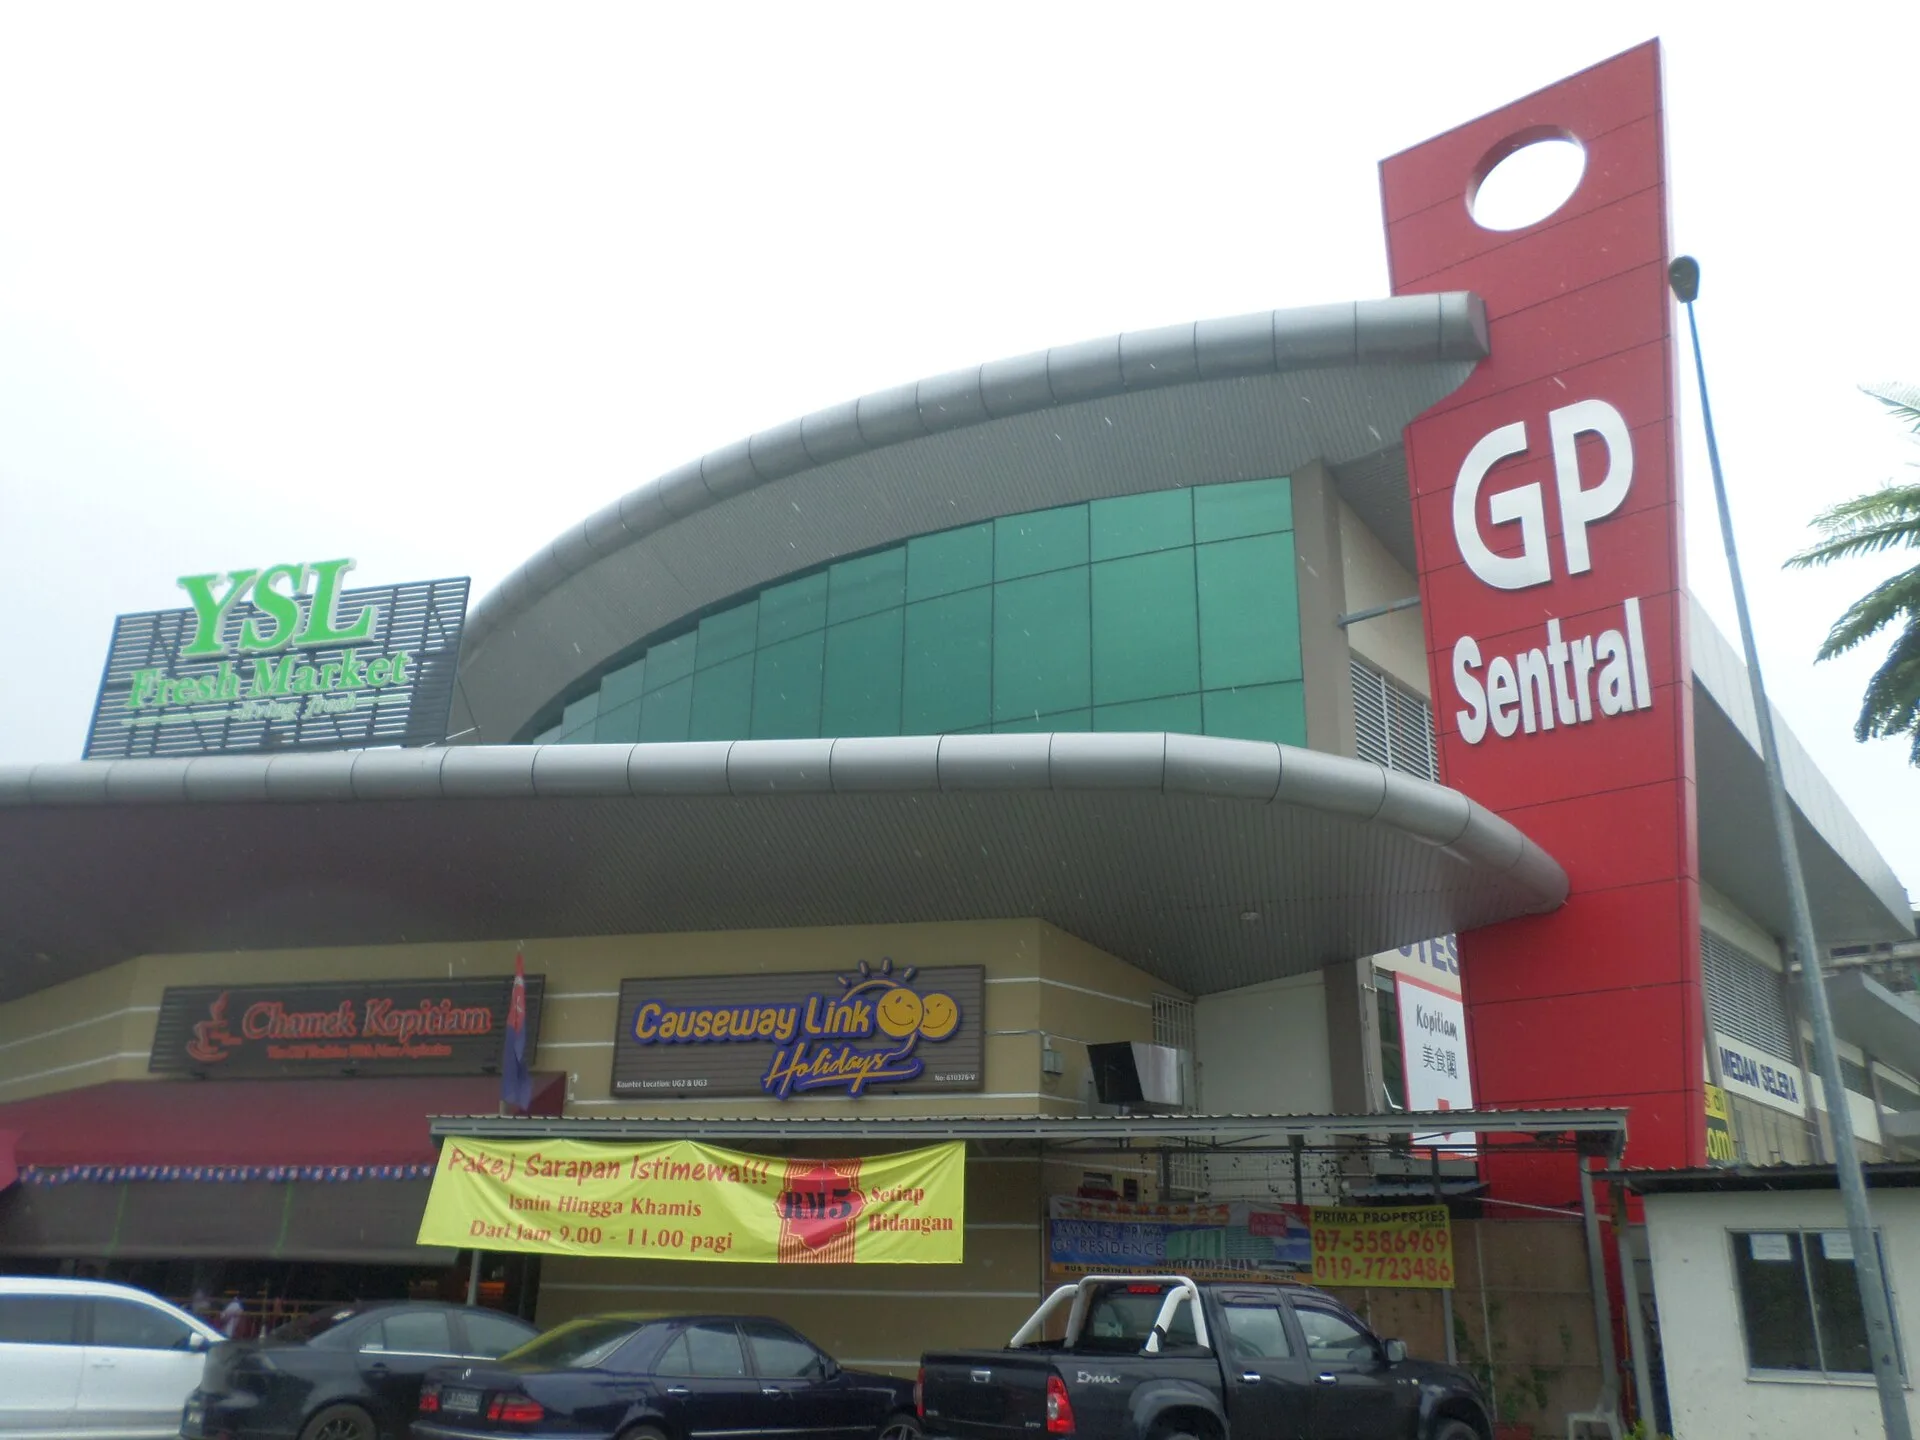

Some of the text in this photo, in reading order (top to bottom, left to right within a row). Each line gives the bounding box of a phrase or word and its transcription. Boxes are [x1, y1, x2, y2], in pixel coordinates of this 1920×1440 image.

[1453, 398, 1634, 590] GP
[177, 557, 379, 659] YSL
[124, 648, 412, 709] Fresh Market
[1453, 596, 1653, 745] Sentral
[362, 998, 492, 1044] Kopitiam
[634, 994, 873, 1042] Causeway Link
[1416, 1003, 1458, 1042] Kopitiam
[762, 1041, 892, 1097] Holidays
[1718, 1046, 1760, 1089] MEDAN
[1759, 1063, 1800, 1105] SELERA
[448, 1147, 771, 1187] Pakej Sarapan Istimewa!!!
[508, 1193, 702, 1218] Isnin Hingga Khamis
[783, 1188, 853, 1221] RM5
[870, 1184, 925, 1206] Setiap
[868, 1213, 954, 1236] Hidangan
[1313, 1210, 1446, 1224] PRIMA PROPERTIES
[469, 1220, 512, 1239] Dari
[517, 1223, 552, 1242] Jam
[559, 1225, 603, 1245] 9.00
[627, 1228, 685, 1248] 11.00
[690, 1231, 734, 1254] pagi
[1079, 1240, 1166, 1257] RESIDENCE
[1314, 1228, 1449, 1254] 07-5586969
[1315, 1255, 1452, 1283] 019-7723486
